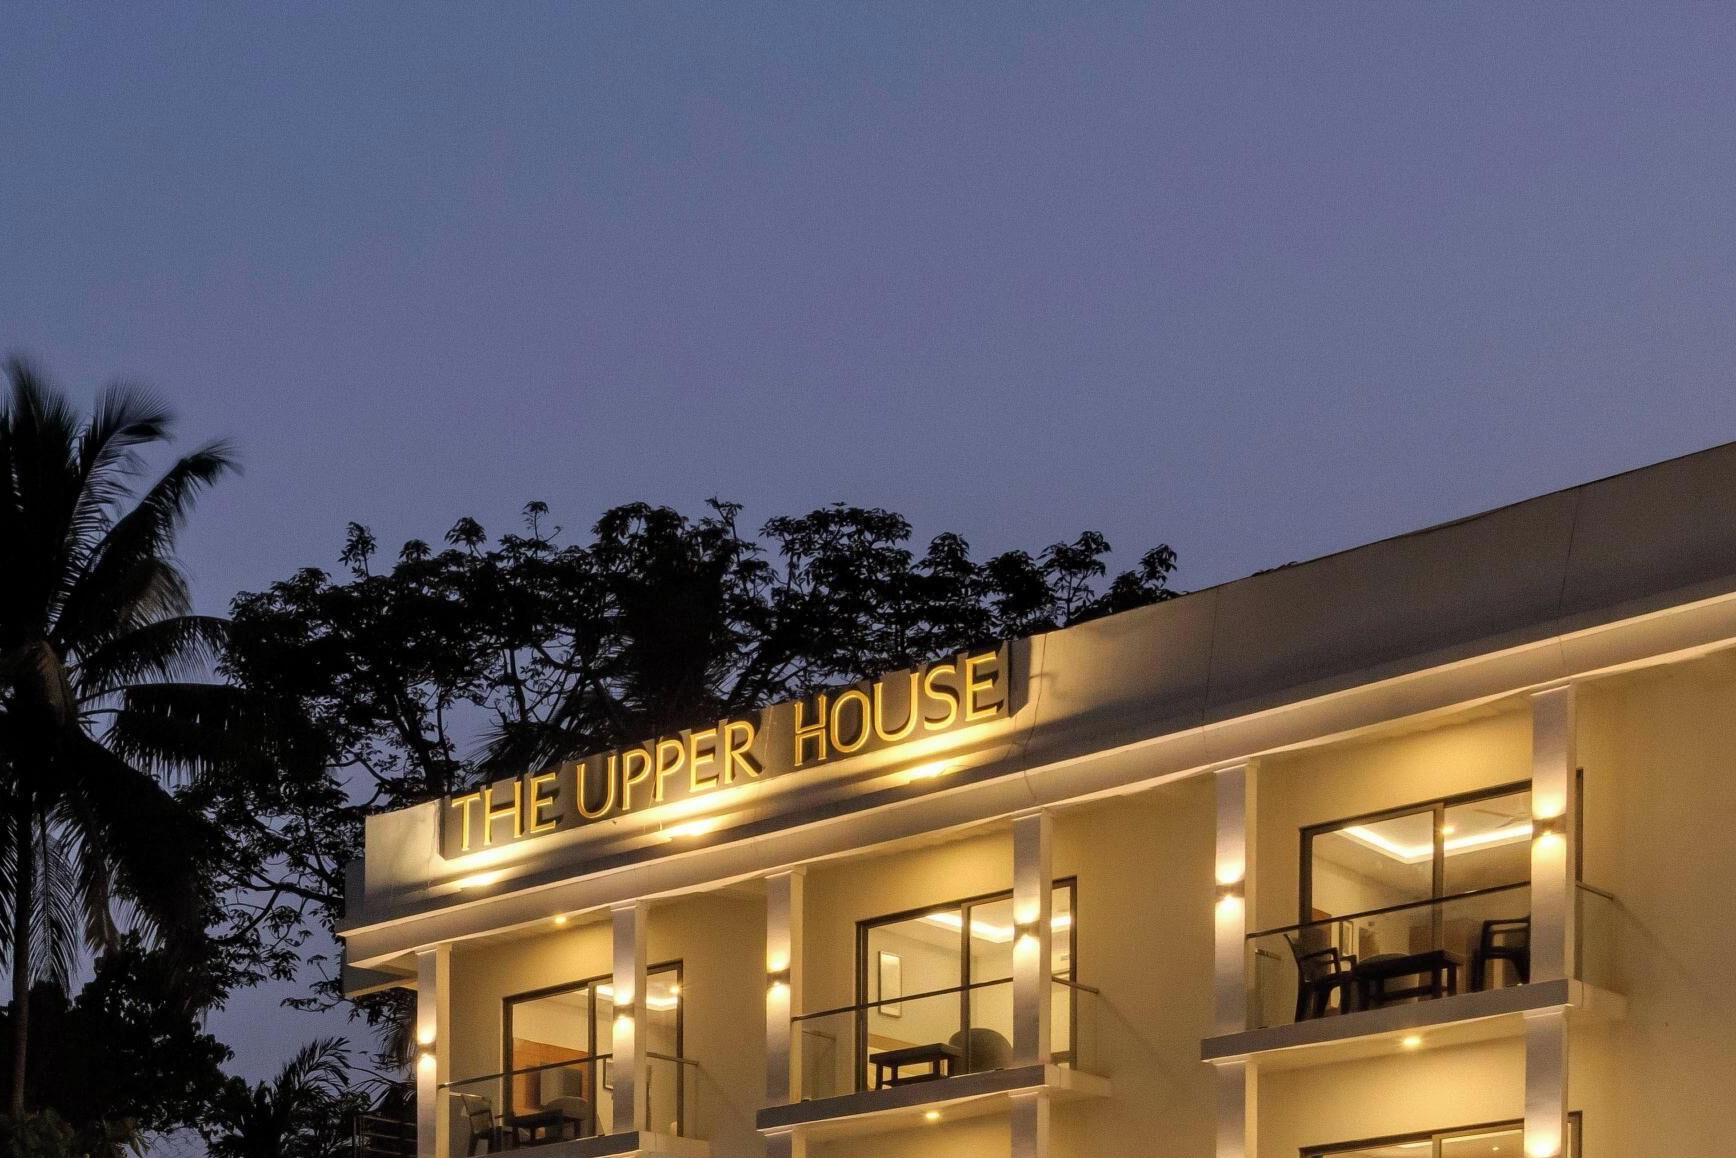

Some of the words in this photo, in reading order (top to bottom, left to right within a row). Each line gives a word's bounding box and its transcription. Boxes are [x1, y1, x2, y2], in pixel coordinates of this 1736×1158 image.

[451, 772, 557, 852] THE
[576, 719, 761, 819] UPPER
[794, 650, 998, 767] HOUSE
